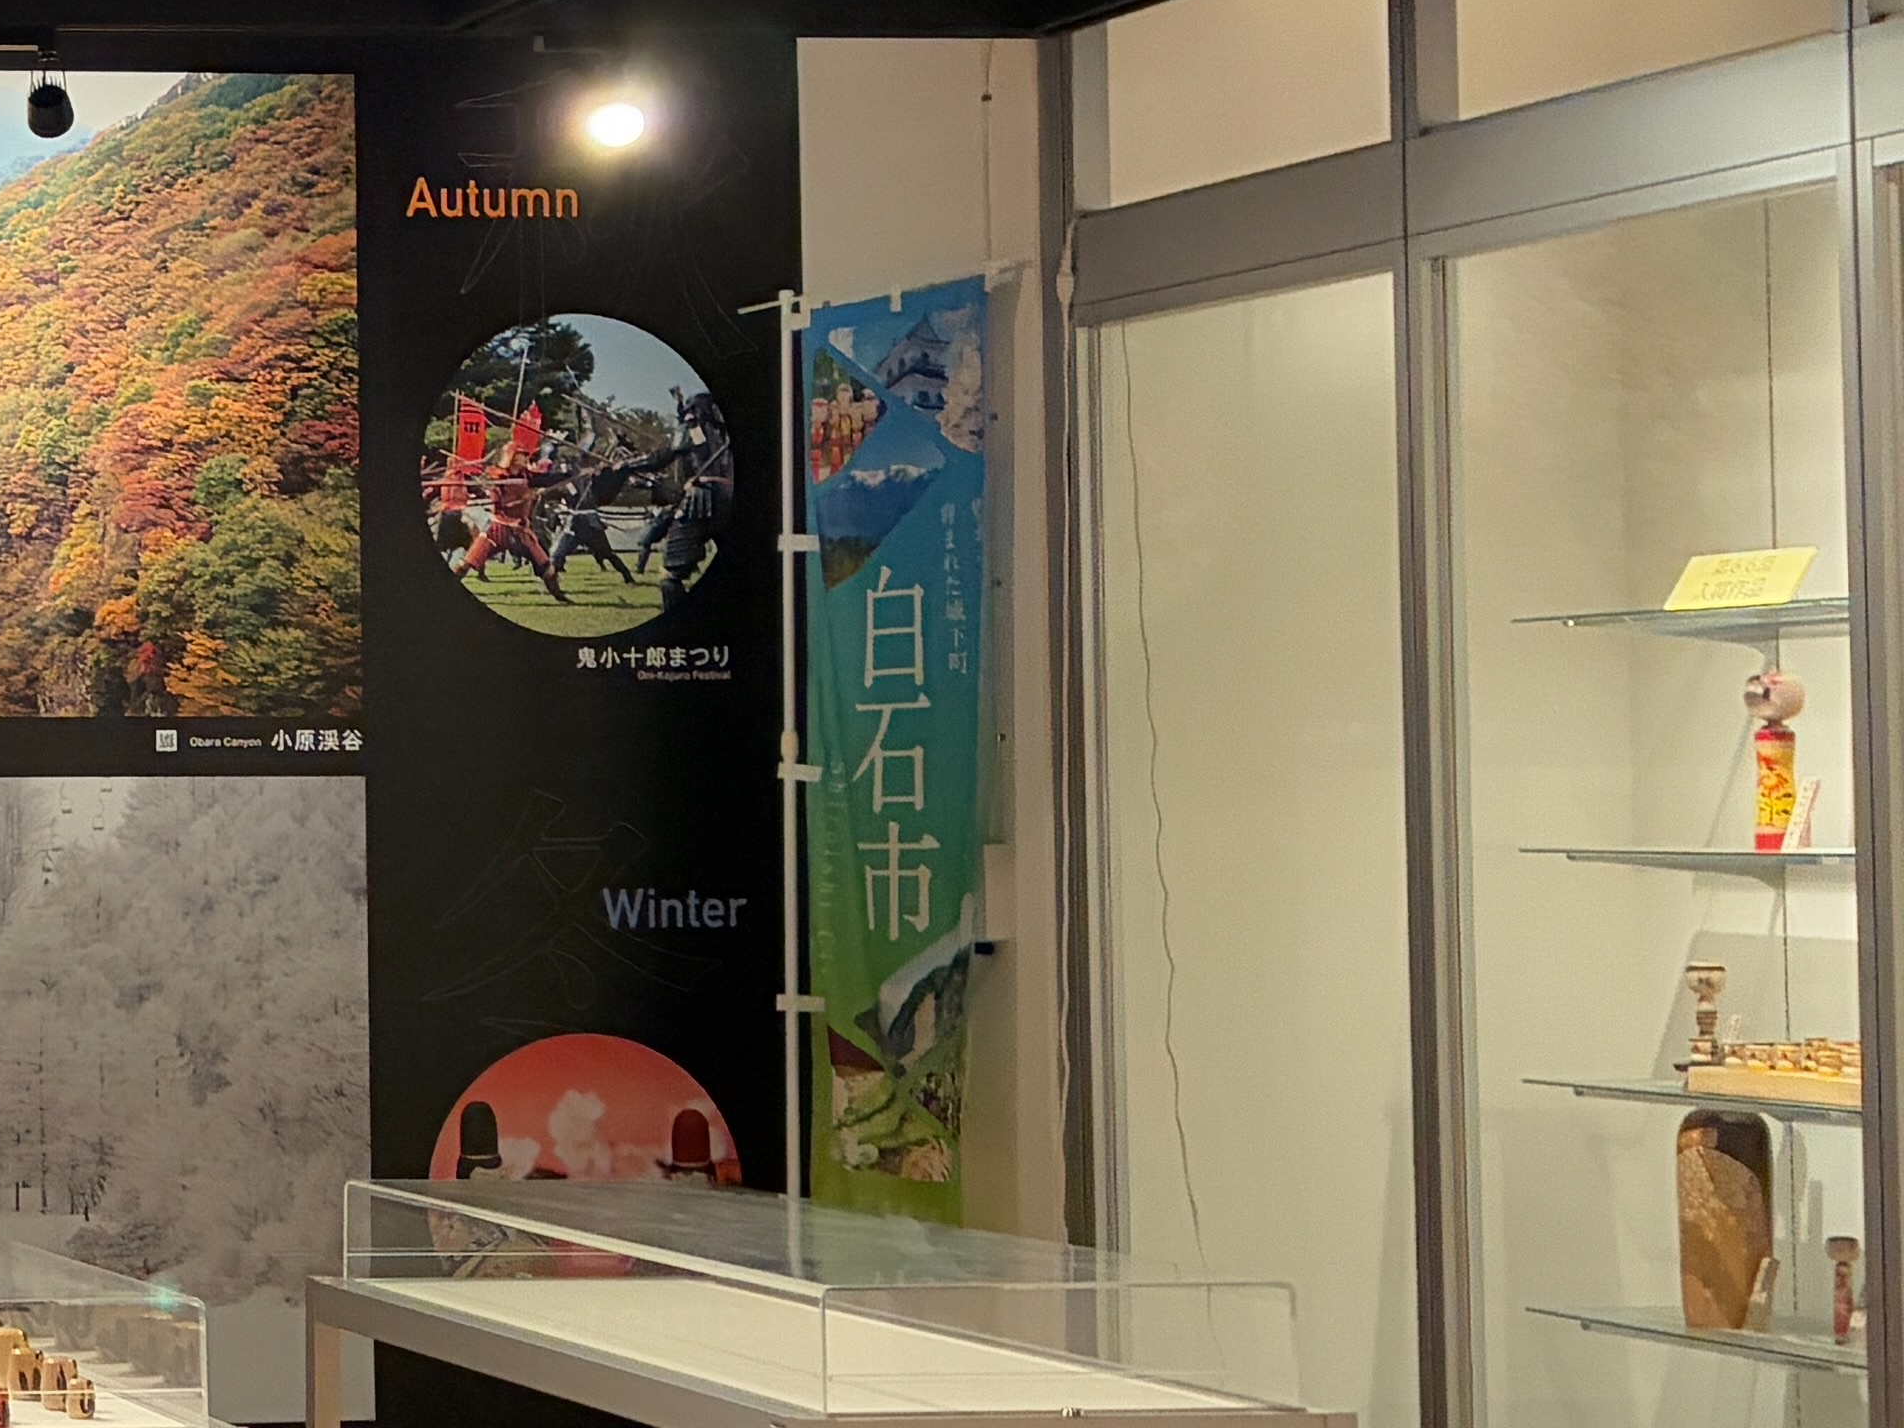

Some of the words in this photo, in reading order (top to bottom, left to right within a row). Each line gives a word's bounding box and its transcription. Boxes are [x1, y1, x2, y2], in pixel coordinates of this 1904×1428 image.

[406, 176, 579, 219] Autumn
[576, 645, 729, 669] 鬼小十郎まつり
[189, 736, 221, 747] Obara
[223, 736, 262, 749] Canyon
[852, 565, 941, 941] 白石市
[602, 886, 747, 930] Winter
